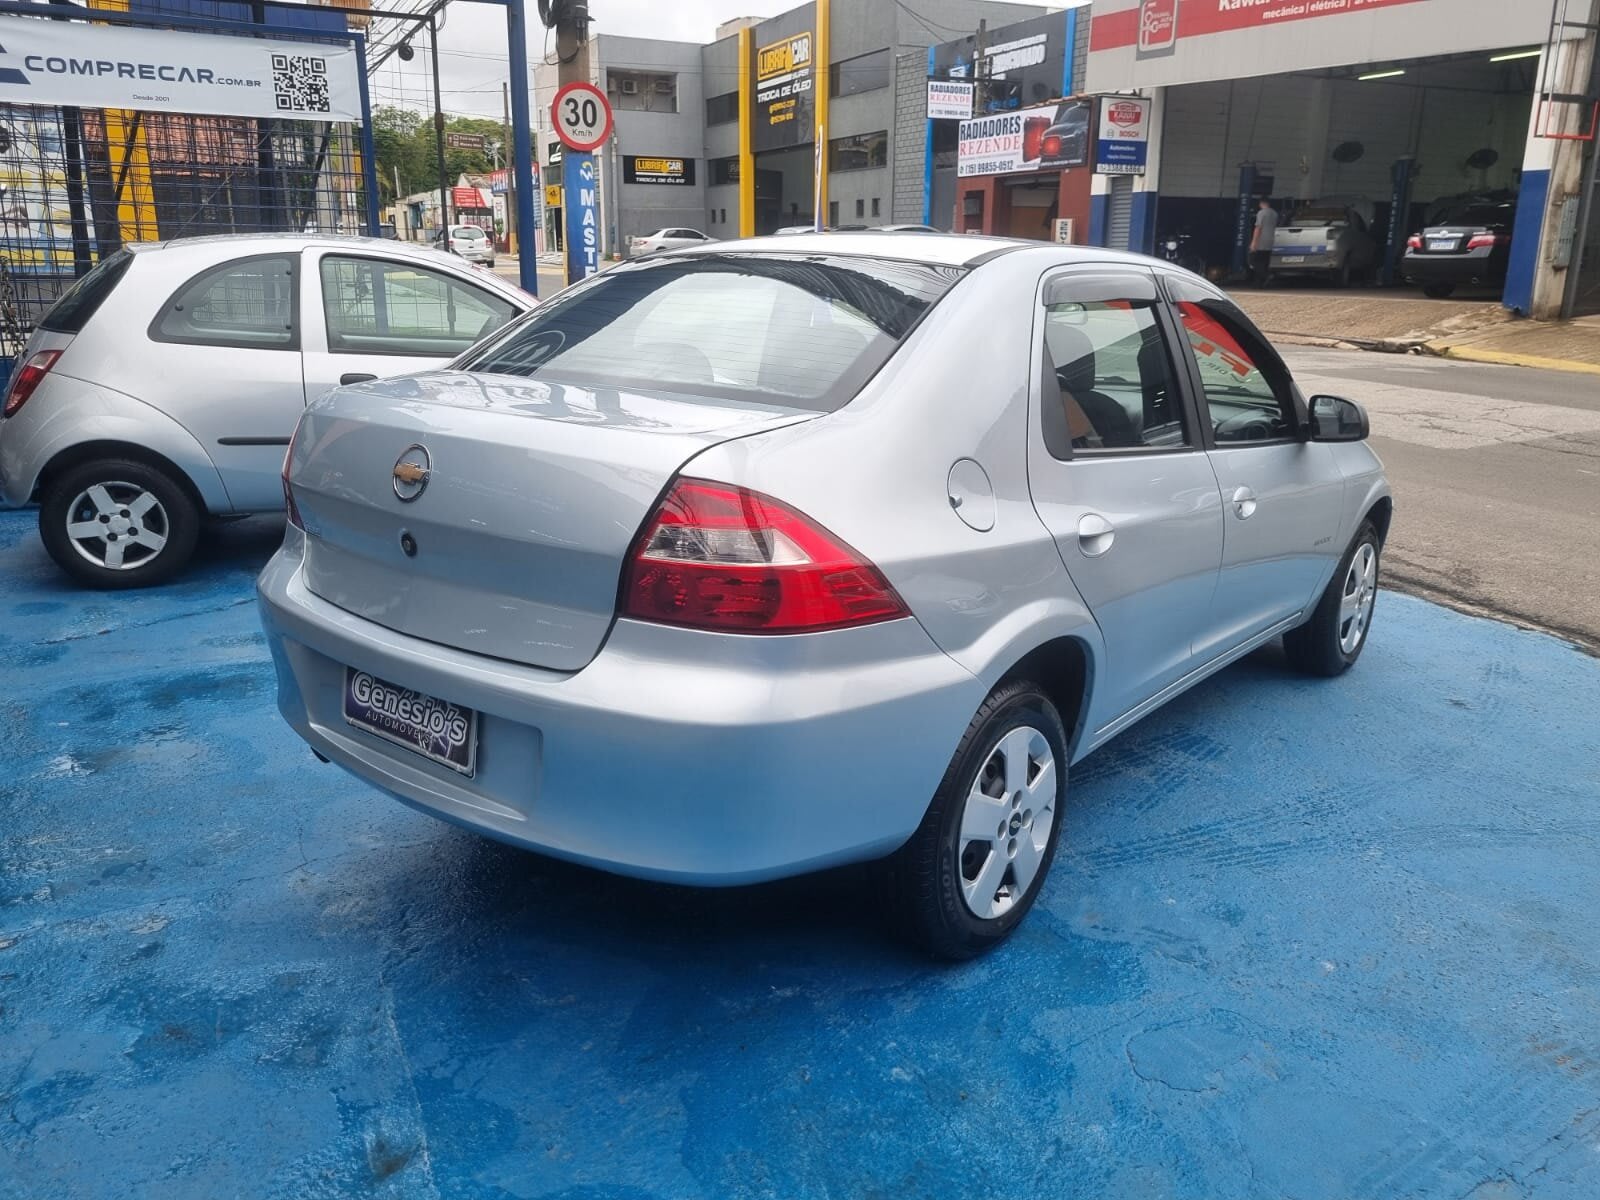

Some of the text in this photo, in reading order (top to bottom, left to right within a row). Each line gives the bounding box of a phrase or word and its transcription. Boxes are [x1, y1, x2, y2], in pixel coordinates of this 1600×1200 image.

[1263, 0, 1345, 19] mecânica elétrica
[757, 79, 812, 103] TROCA DE ÓLEO
[930, 84, 971, 95] RADIADORES
[930, 94, 971, 104] REZENDE
[565, 97, 597, 128] 30
[572, 128, 593, 137] Km/h
[960, 115, 1021, 141] RADIADORES
[959, 135, 1021, 157] REZENDE
[353, 671, 467, 744] Genésio's
